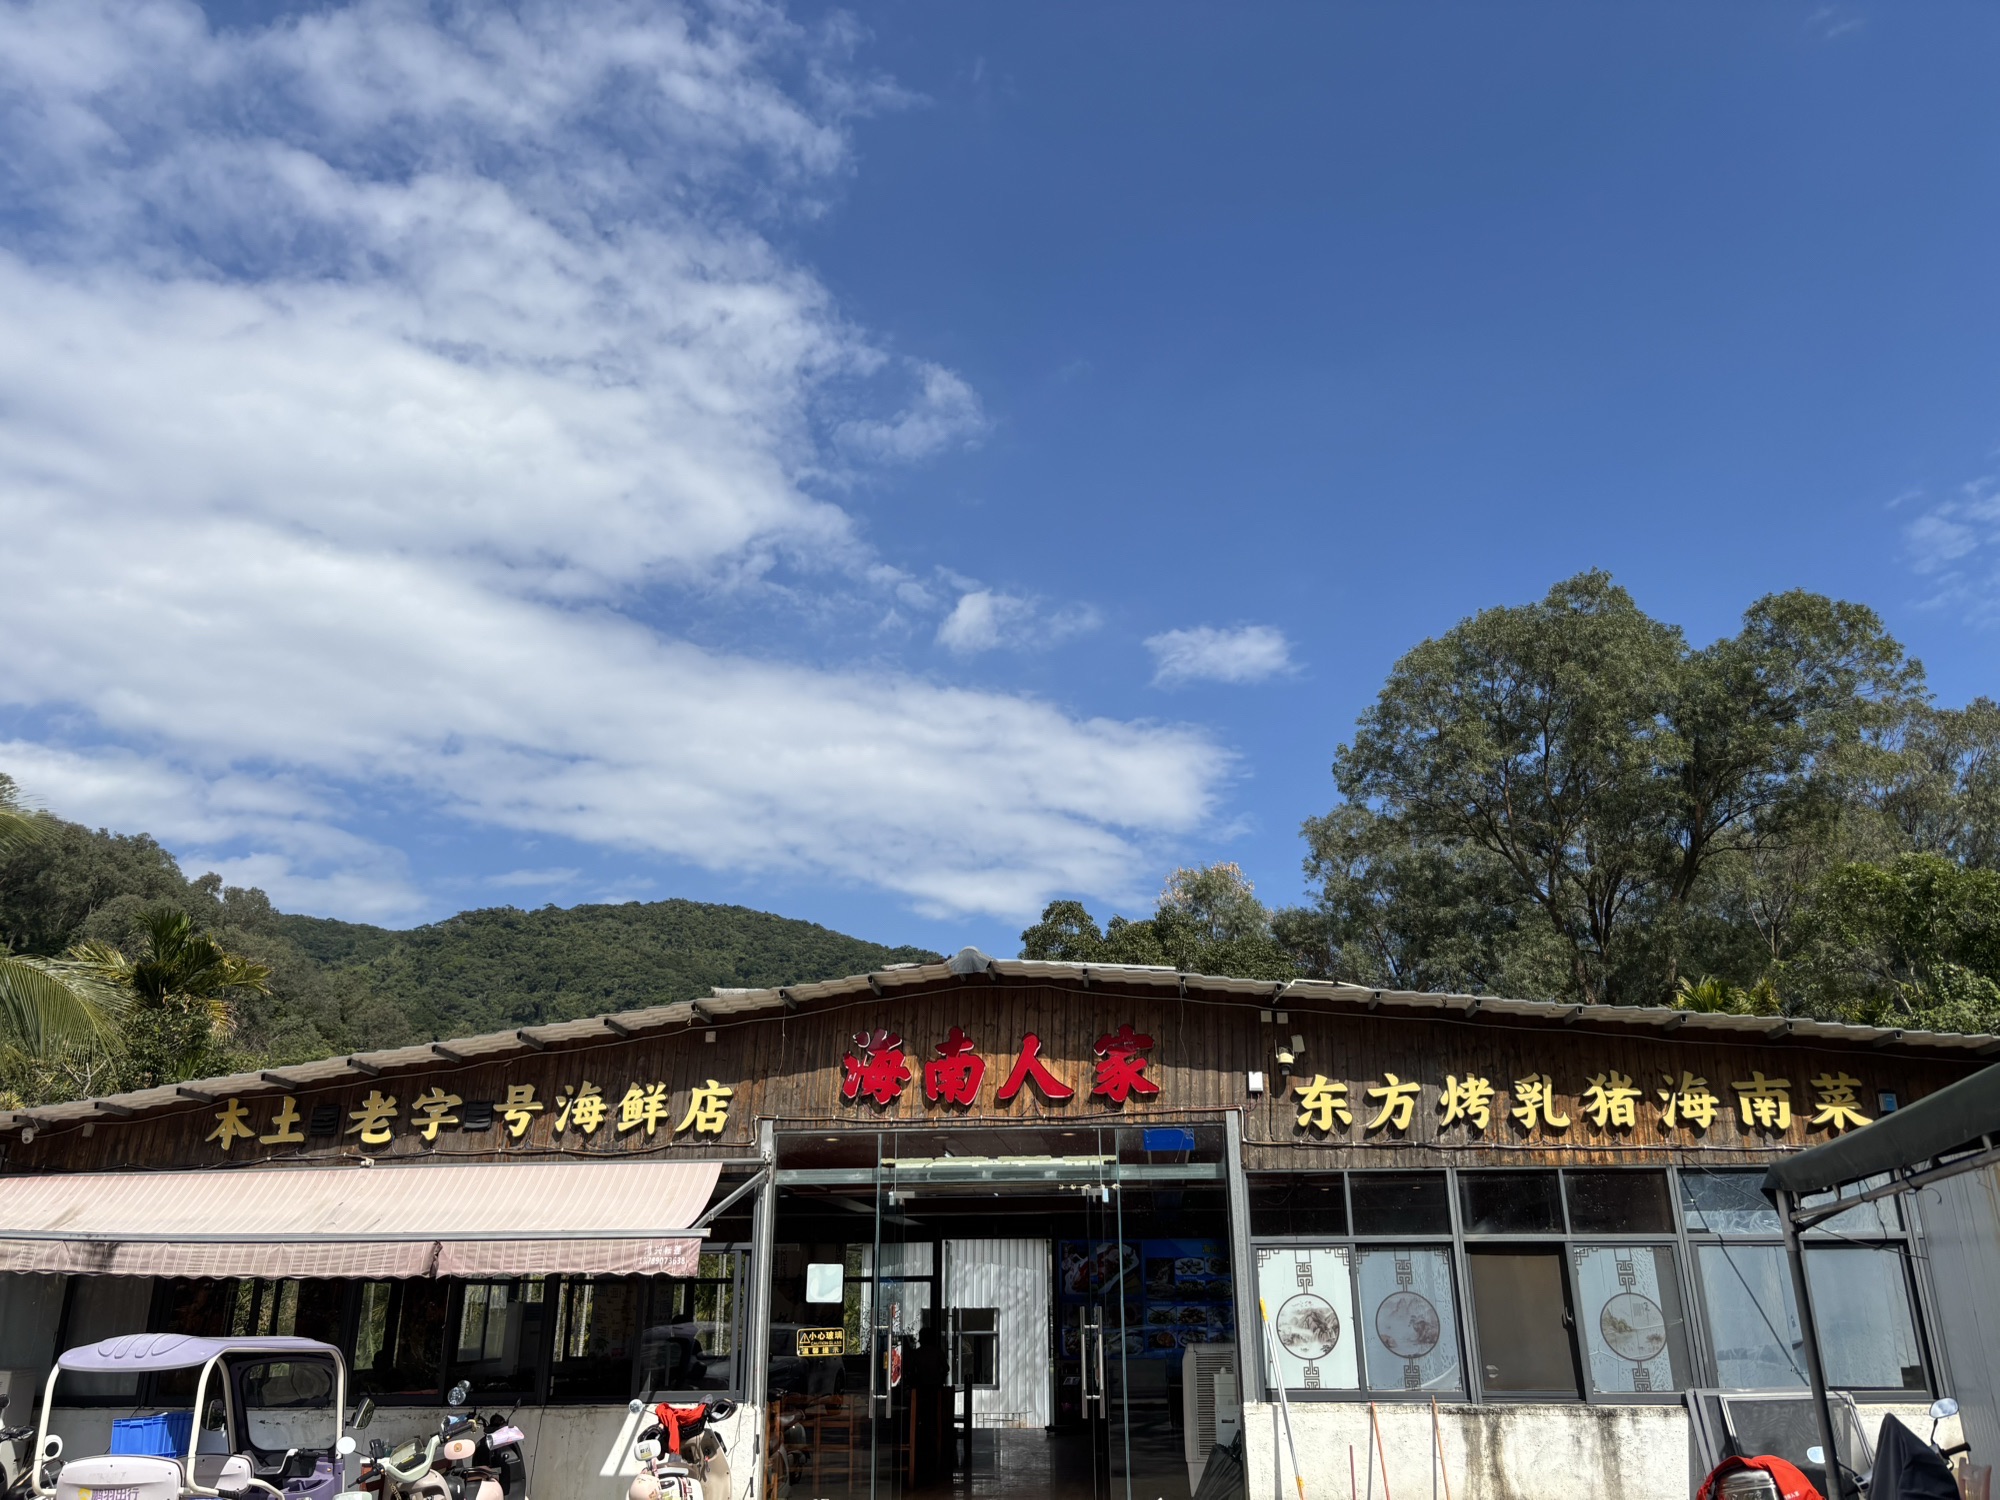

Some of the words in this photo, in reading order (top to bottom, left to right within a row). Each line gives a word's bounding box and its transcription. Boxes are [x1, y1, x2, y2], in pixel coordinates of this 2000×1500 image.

[842, 1025, 1160, 1105] 海南人家
[1294, 1071, 1874, 1131] 东方烤乳猪海南菜
[809, 1331, 842, 1340] 小心玻璃
